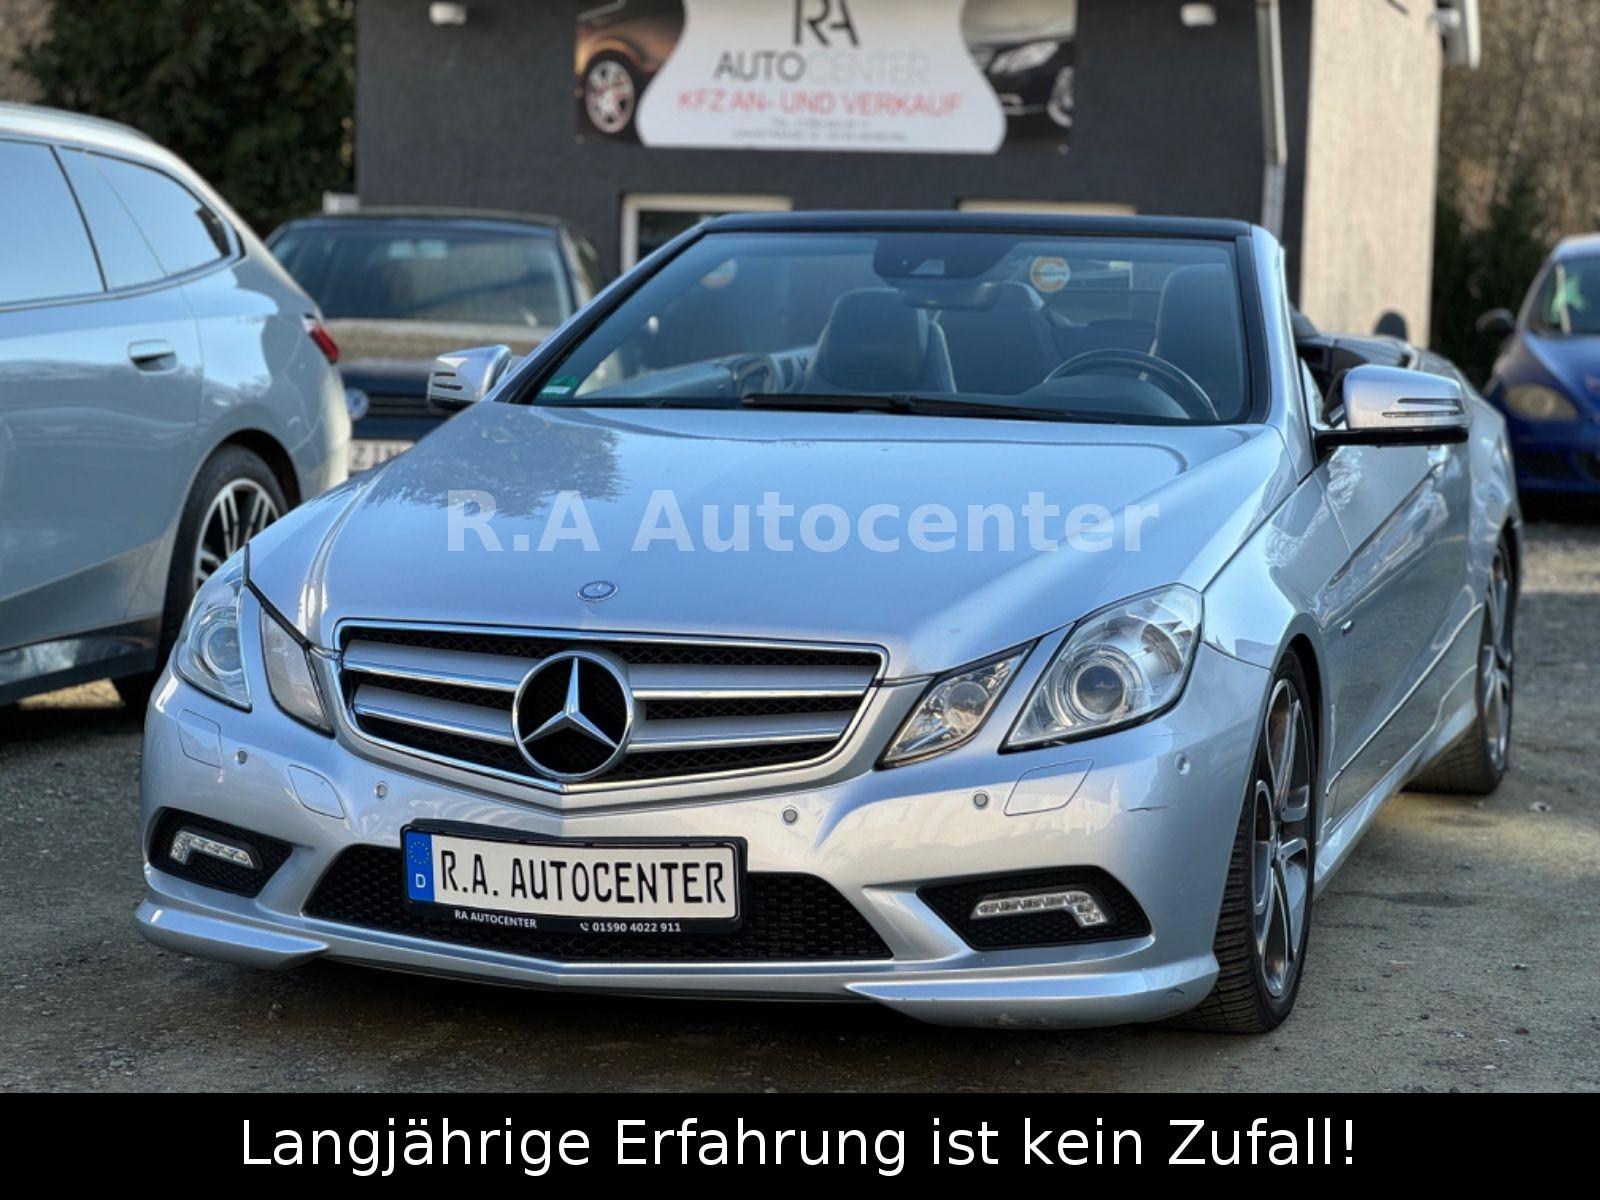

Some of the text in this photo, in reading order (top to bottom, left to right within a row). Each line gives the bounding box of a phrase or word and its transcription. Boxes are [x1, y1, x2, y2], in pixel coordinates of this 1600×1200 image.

[780, 90, 835, 115] UND
[841, 92, 962, 117] VERKAUF
[415, 873, 426, 888] D
[440, 850, 726, 903] R.A. AUTOCENTER
[454, 909, 537, 929] RA AUTOCENTER
[592, 921, 681, 933] 01590 4022 911
